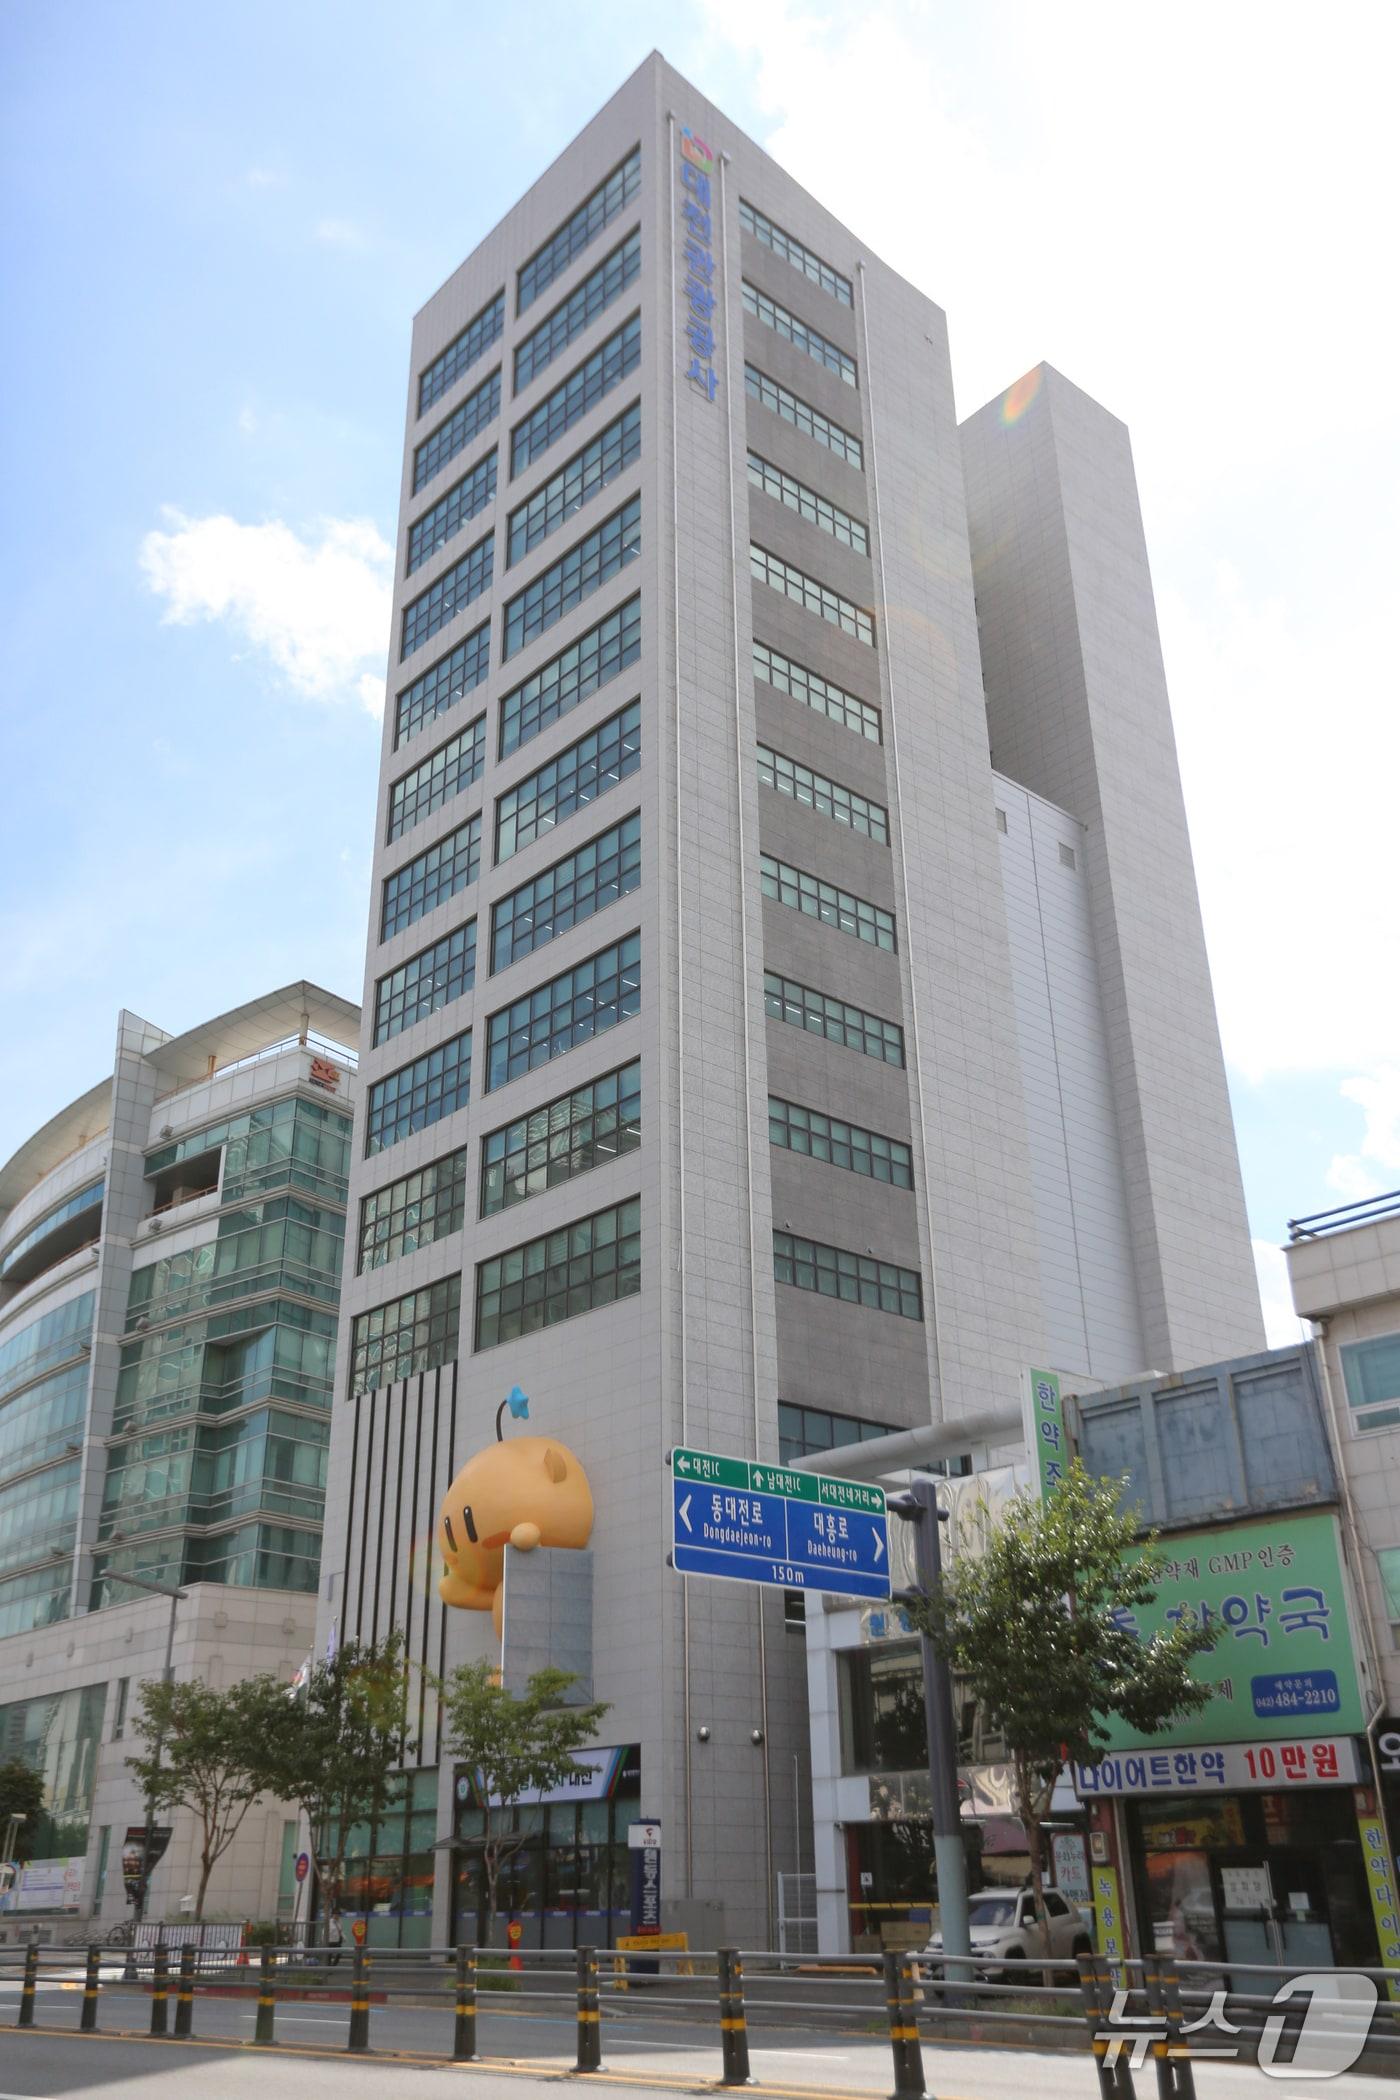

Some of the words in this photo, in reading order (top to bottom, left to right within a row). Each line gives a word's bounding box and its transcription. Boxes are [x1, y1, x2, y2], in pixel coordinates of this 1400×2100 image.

[680, 161, 719, 402] 대전관광공사
[693, 1457, 720, 1479] 대전IC
[766, 1472, 801, 1494] 남대전IC
[821, 1482, 871, 1506] 서대전네거리
[711, 1494, 764, 1527] 동대전로
[703, 1521, 772, 1549] Dongdaejeon-ro
[813, 1511, 850, 1544] 대흥로
[807, 1539, 858, 1563] Daeheung-ro
[771, 1564, 805, 1584] 150m
[1243, 1743, 1340, 1780] 10만원
